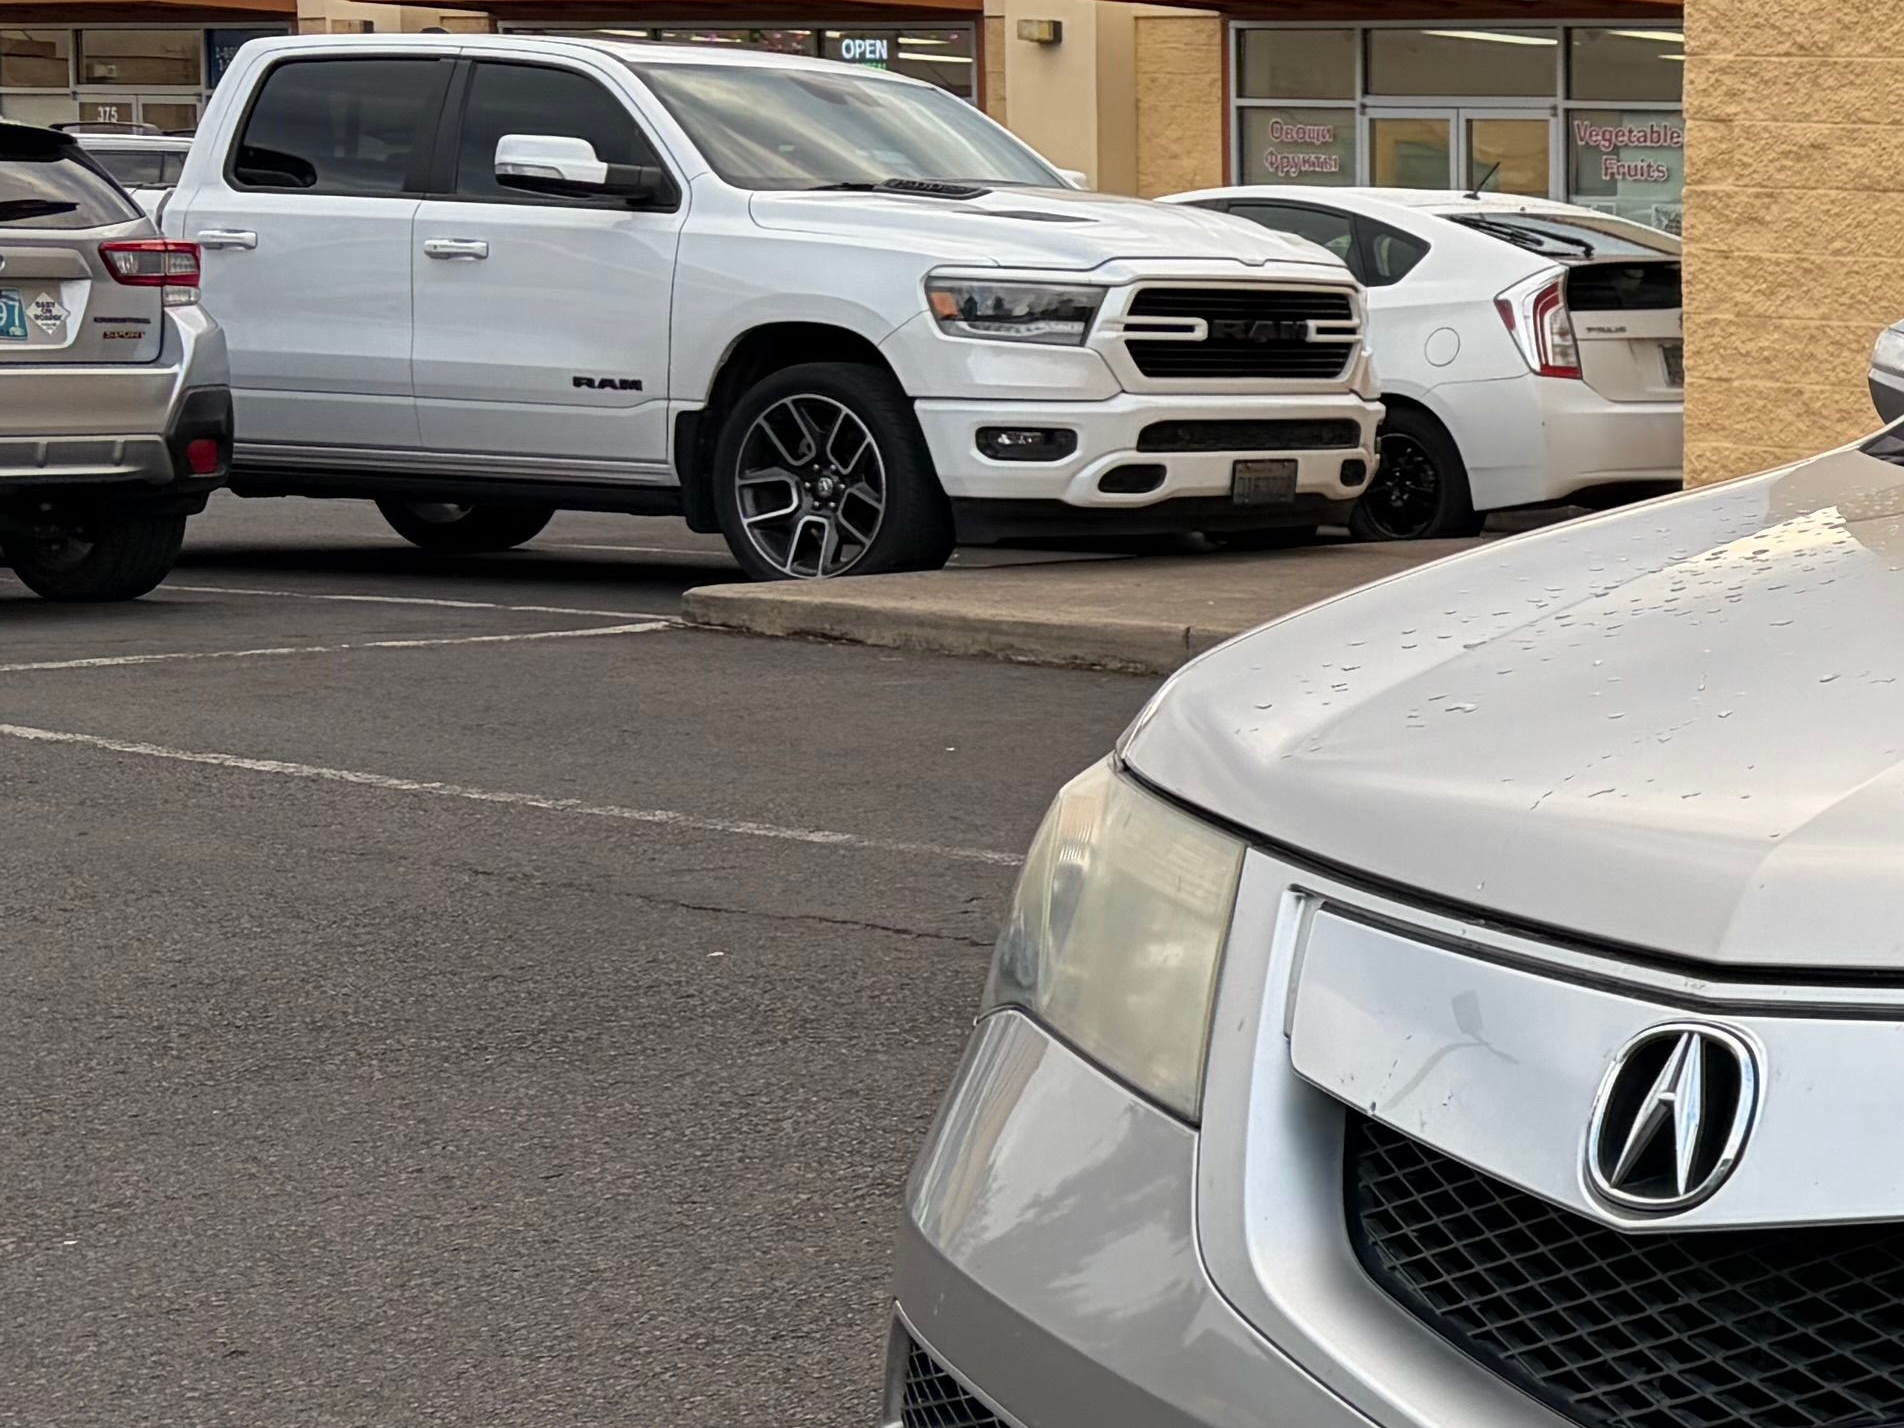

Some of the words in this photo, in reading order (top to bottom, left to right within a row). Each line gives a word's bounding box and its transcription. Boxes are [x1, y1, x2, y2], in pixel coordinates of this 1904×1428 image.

[841, 38, 889, 60] OPEN
[97, 106, 118, 123] 375
[1269, 118, 1334, 145] Овощи
[1264, 148, 1341, 176] Фрукты
[1602, 155, 1668, 181] Fruits
[572, 376, 643, 392] RAM
